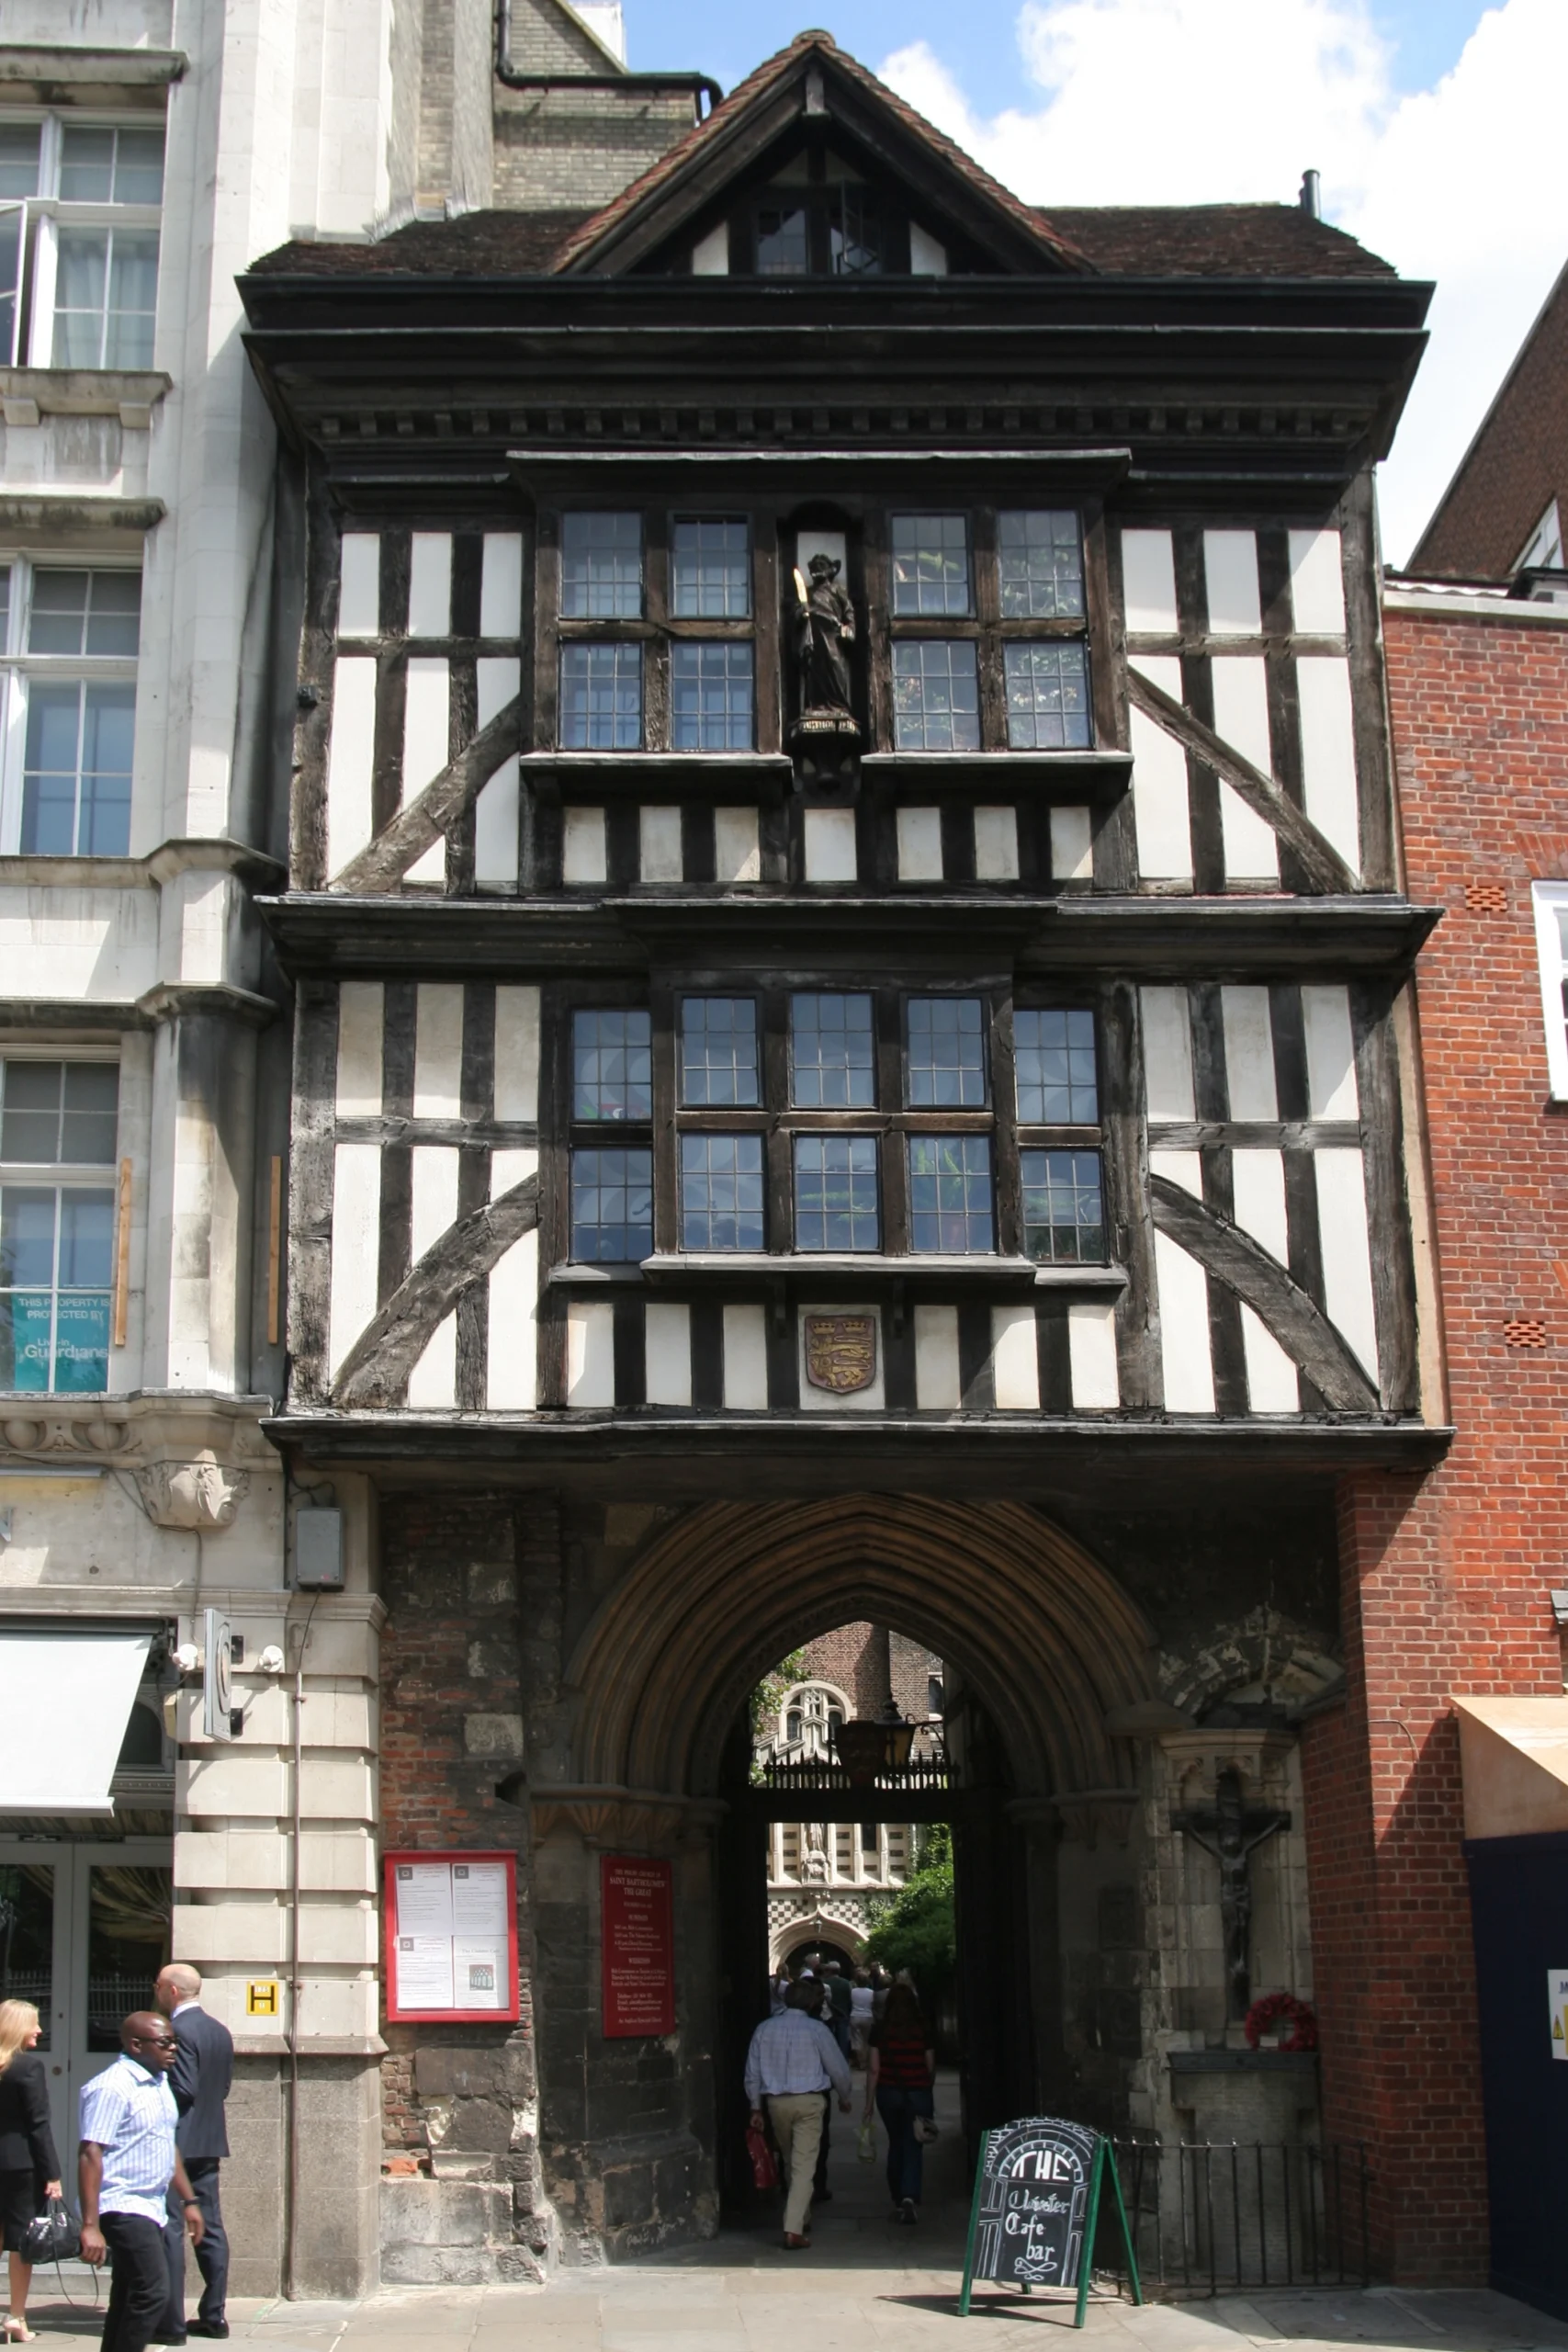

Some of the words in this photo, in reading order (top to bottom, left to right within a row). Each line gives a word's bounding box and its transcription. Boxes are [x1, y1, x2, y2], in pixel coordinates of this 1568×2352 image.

[18, 1298, 42, 1306] THIS
[44, 1298, 97, 1307] POPERTY
[100, 1298, 109, 1307] IS
[90, 1310, 104, 1320] BY
[37, 1338, 70, 1347] Liv-in
[25, 1344, 108, 1360] Gurdians
[610, 1876, 625, 1885] SAINT
[623, 1887, 634, 1895] THE
[635, 1888, 651, 1896] GREAT
[250, 1984, 275, 2012] H
[1011, 2151, 1072, 2180] THE
[1005, 2212, 1045, 2237] Cafe
[1026, 2240, 1055, 2262] bar
